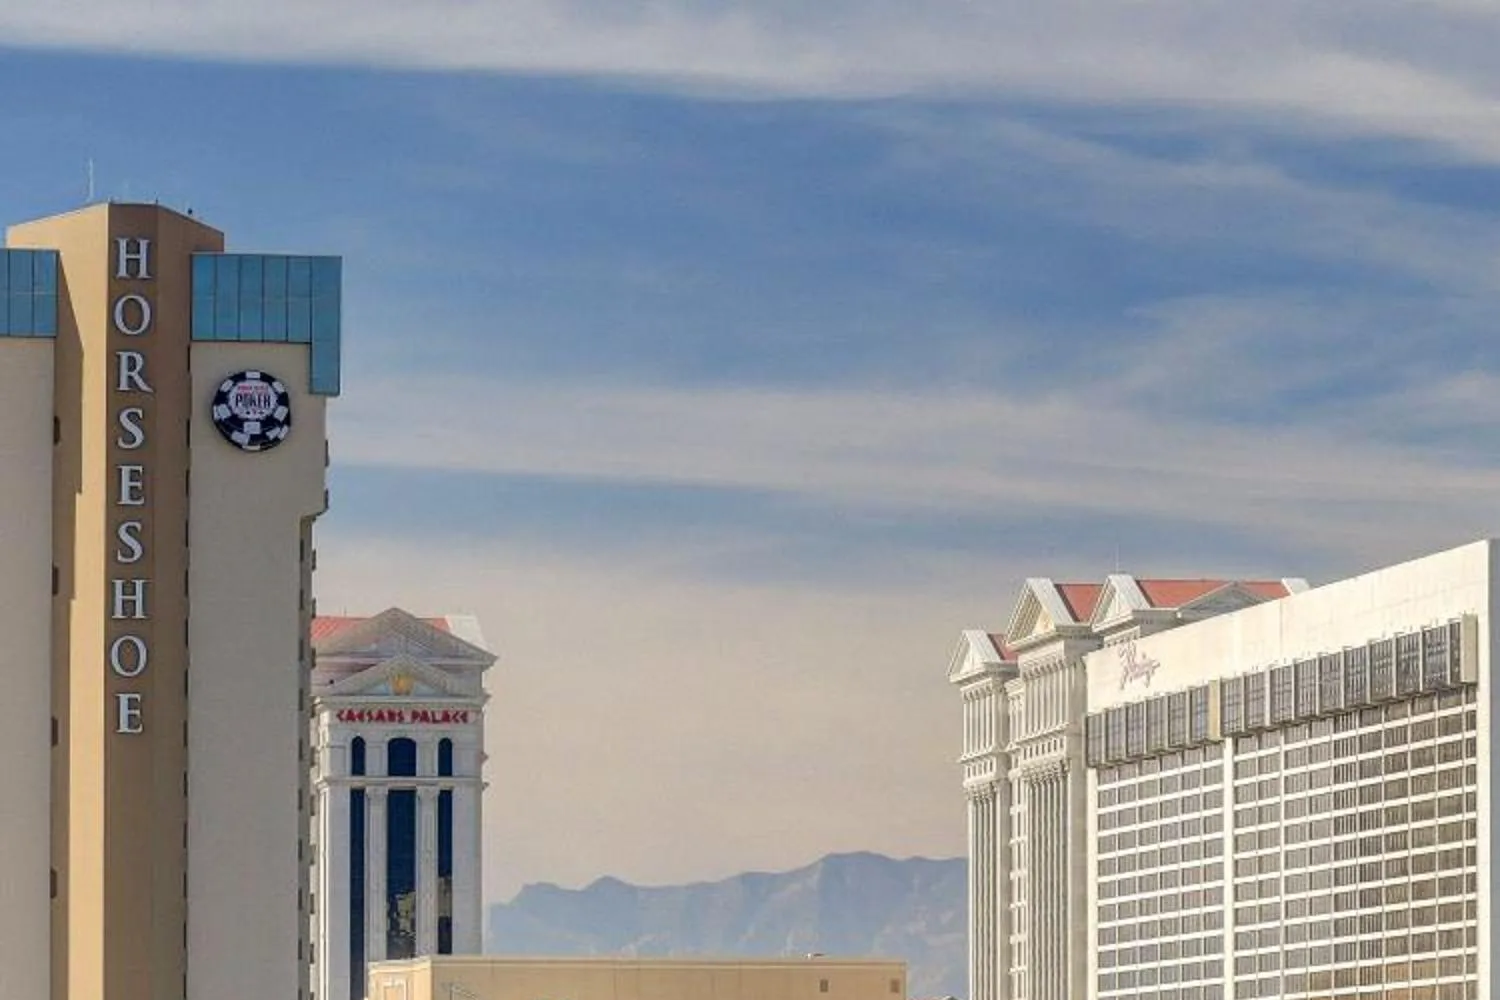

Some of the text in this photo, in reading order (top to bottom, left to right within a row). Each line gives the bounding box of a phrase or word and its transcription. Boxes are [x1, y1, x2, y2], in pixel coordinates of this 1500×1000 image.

[111, 237, 152, 733] HORSESHOE
[337, 708, 468, 724] CAESARS PALACE
